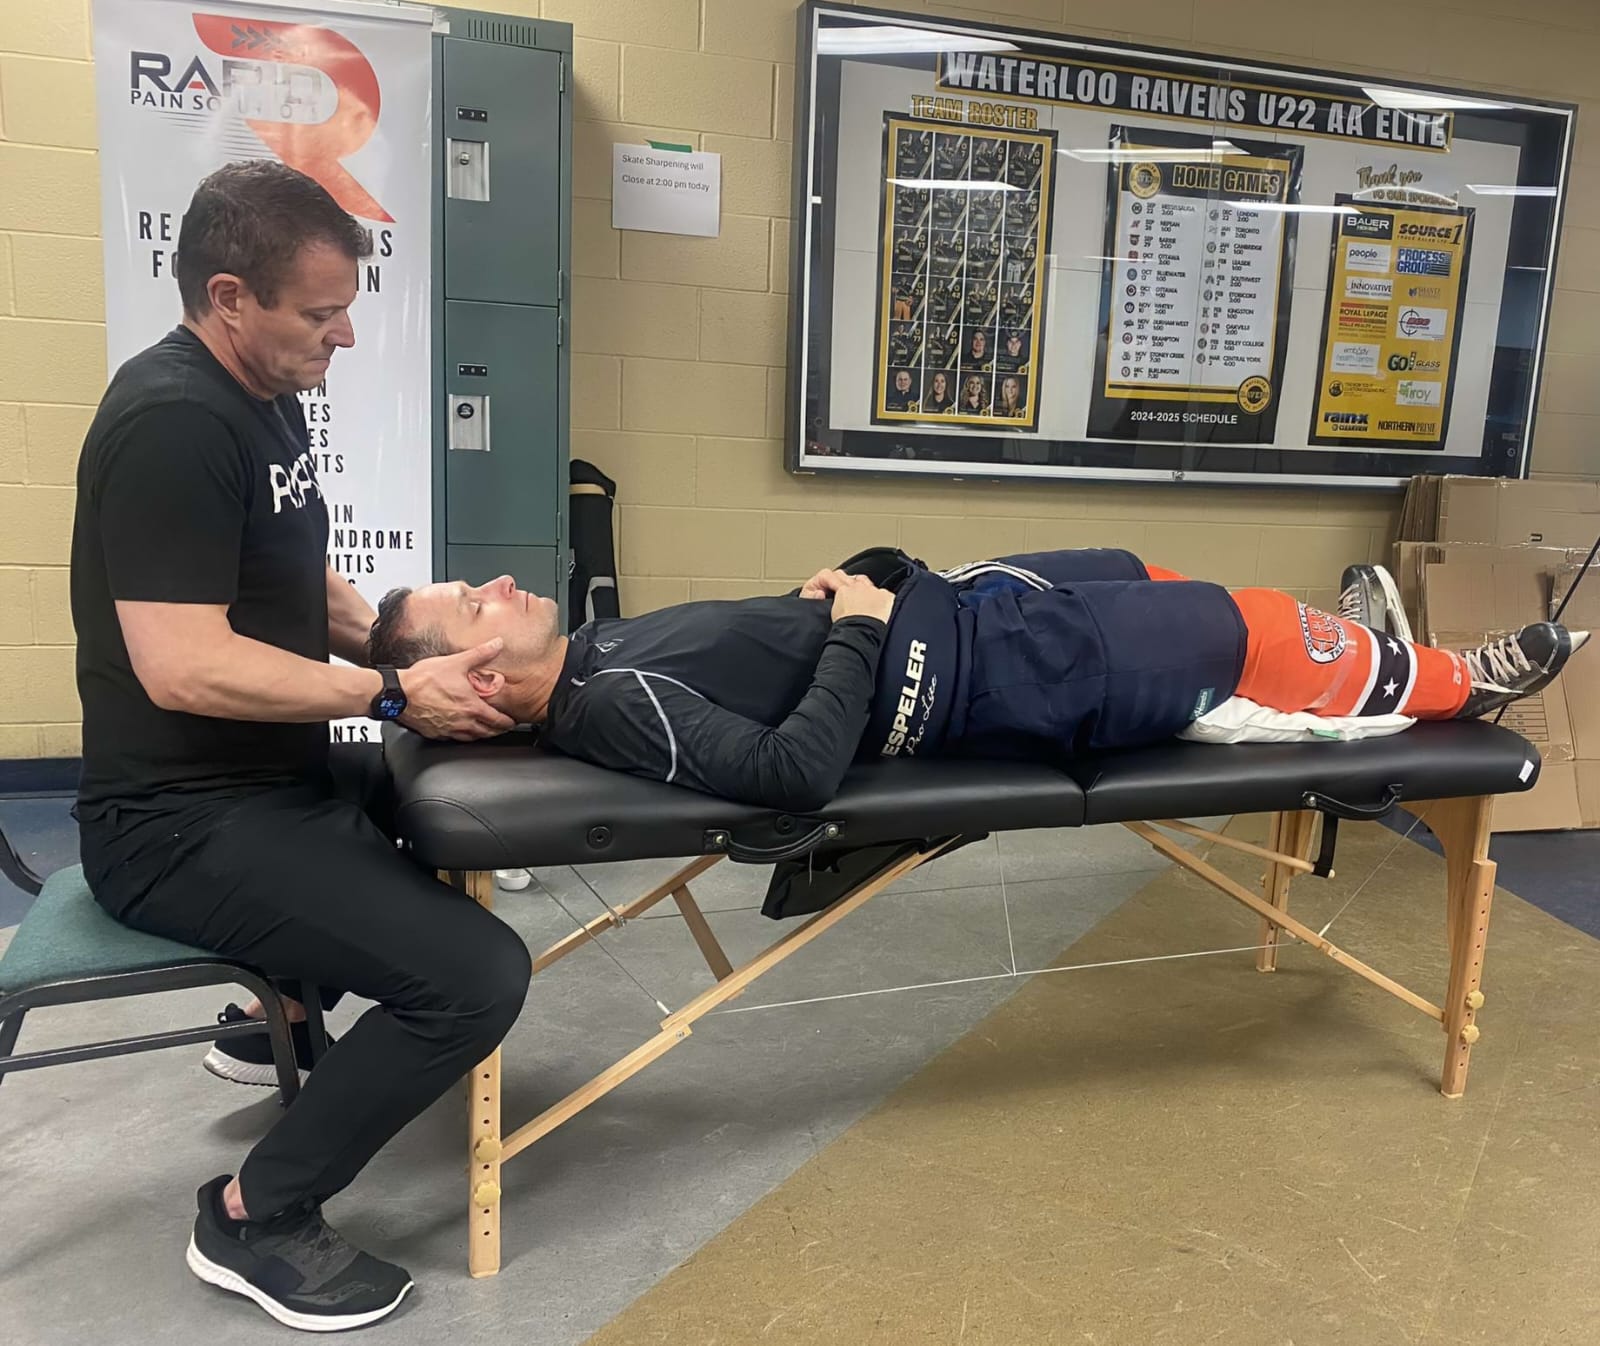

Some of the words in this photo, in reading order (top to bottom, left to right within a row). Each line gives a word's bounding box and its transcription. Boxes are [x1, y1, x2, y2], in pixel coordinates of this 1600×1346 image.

[132, 90, 183, 108] PAIN
[948, 52, 1117, 106] WATERLOO
[1130, 75, 1246, 122] RAVENS
[1258, 92, 1315, 130] U22
[1327, 102, 1363, 136] AA
[1376, 108, 1446, 147] ELITE
[912, 95, 962, 122] TEAM
[968, 102, 1038, 129] ROSTER
[622, 155, 644, 164] Skate
[646, 157, 689, 171] Sharpening
[690, 162, 703, 170] will
[622, 175, 645, 184] Close
[656, 179, 672, 187] 2:00
[688, 182, 709, 192] today
[1173, 165, 1220, 189] HOME
[1224, 170, 1279, 195] GAMES
[1357, 164, 1397, 188] Thank
[1399, 170, 1423, 186] you
[1347, 217, 1389, 230] BAUER
[1399, 224, 1452, 238] SOURCE
[1450, 224, 1463, 244] 1
[1349, 249, 1377, 259] people
[1399, 249, 1446, 263] PROCESS
[1397, 261, 1431, 274] GROUP
[1351, 280, 1392, 292] INNOVATIVE
[1340, 308, 1361, 316] ROYAL
[1416, 360, 1440, 368] GLASS
[1130, 411, 1180, 422] 2024-2025
[1183, 412, 1237, 424] SCHEDULE
[1378, 421, 1415, 431] NORTHERN
[335, 504, 352, 523] IN
[335, 529, 413, 549] NDROME
[327, 554, 375, 573] ITIS
[921, 674, 937, 720] Lite
[334, 726, 368, 743] NTS
[905, 723, 924, 755] Pro
